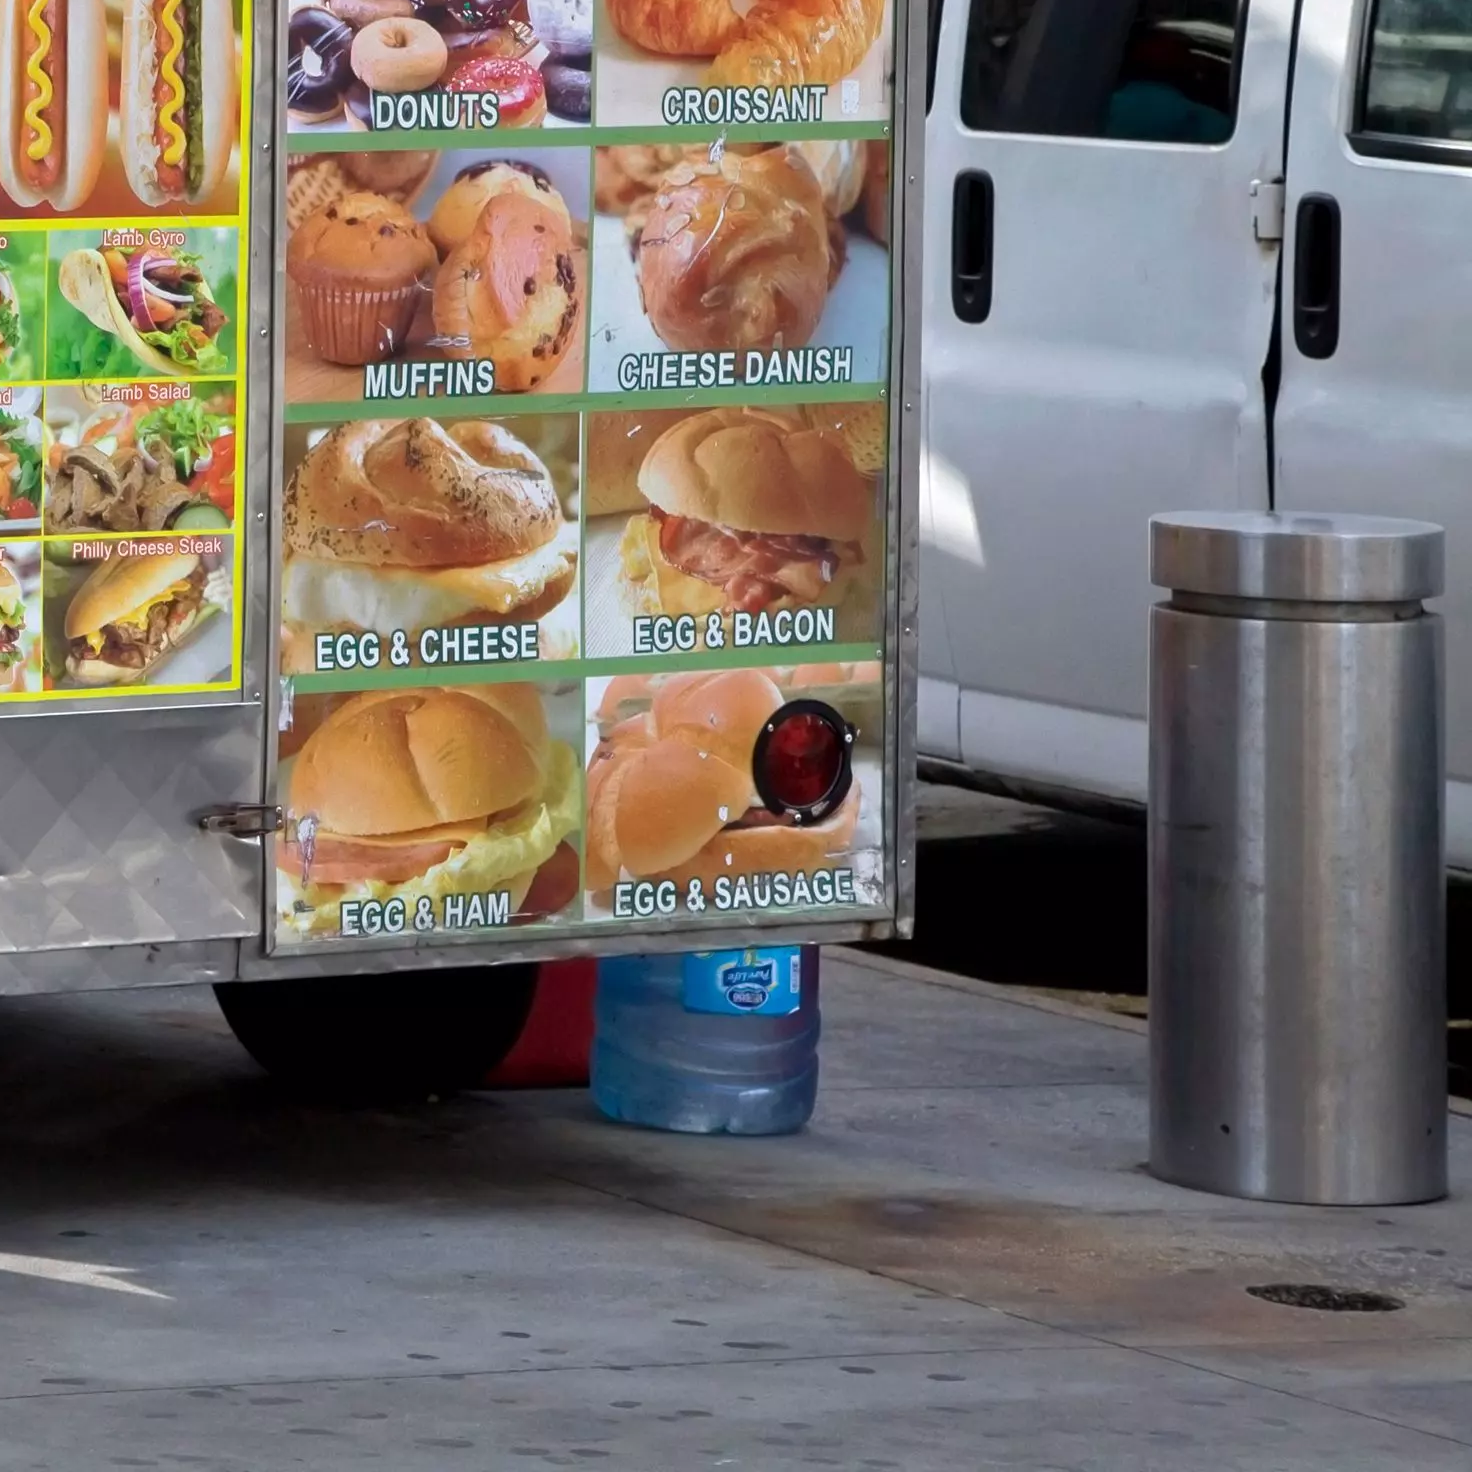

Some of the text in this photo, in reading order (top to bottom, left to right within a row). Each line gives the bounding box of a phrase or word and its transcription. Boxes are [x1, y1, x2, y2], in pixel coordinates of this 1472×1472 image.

[373, 91, 500, 130] DONUTS
[662, 84, 829, 125] CROISSANT
[103, 227, 186, 248] Lamb Gyro
[363, 358, 495, 400] MUFFINS
[617, 346, 853, 390] CHEESE DANISH
[101, 383, 191, 402] Lamb Salad
[72, 537, 222, 562] Philly Cheese Steak
[314, 623, 539, 671] EGG & CHEESE
[633, 608, 834, 654] EGG & BACON
[613, 866, 855, 918] EGG & SAUSAGE
[339, 891, 510, 937] EGG & HAM
